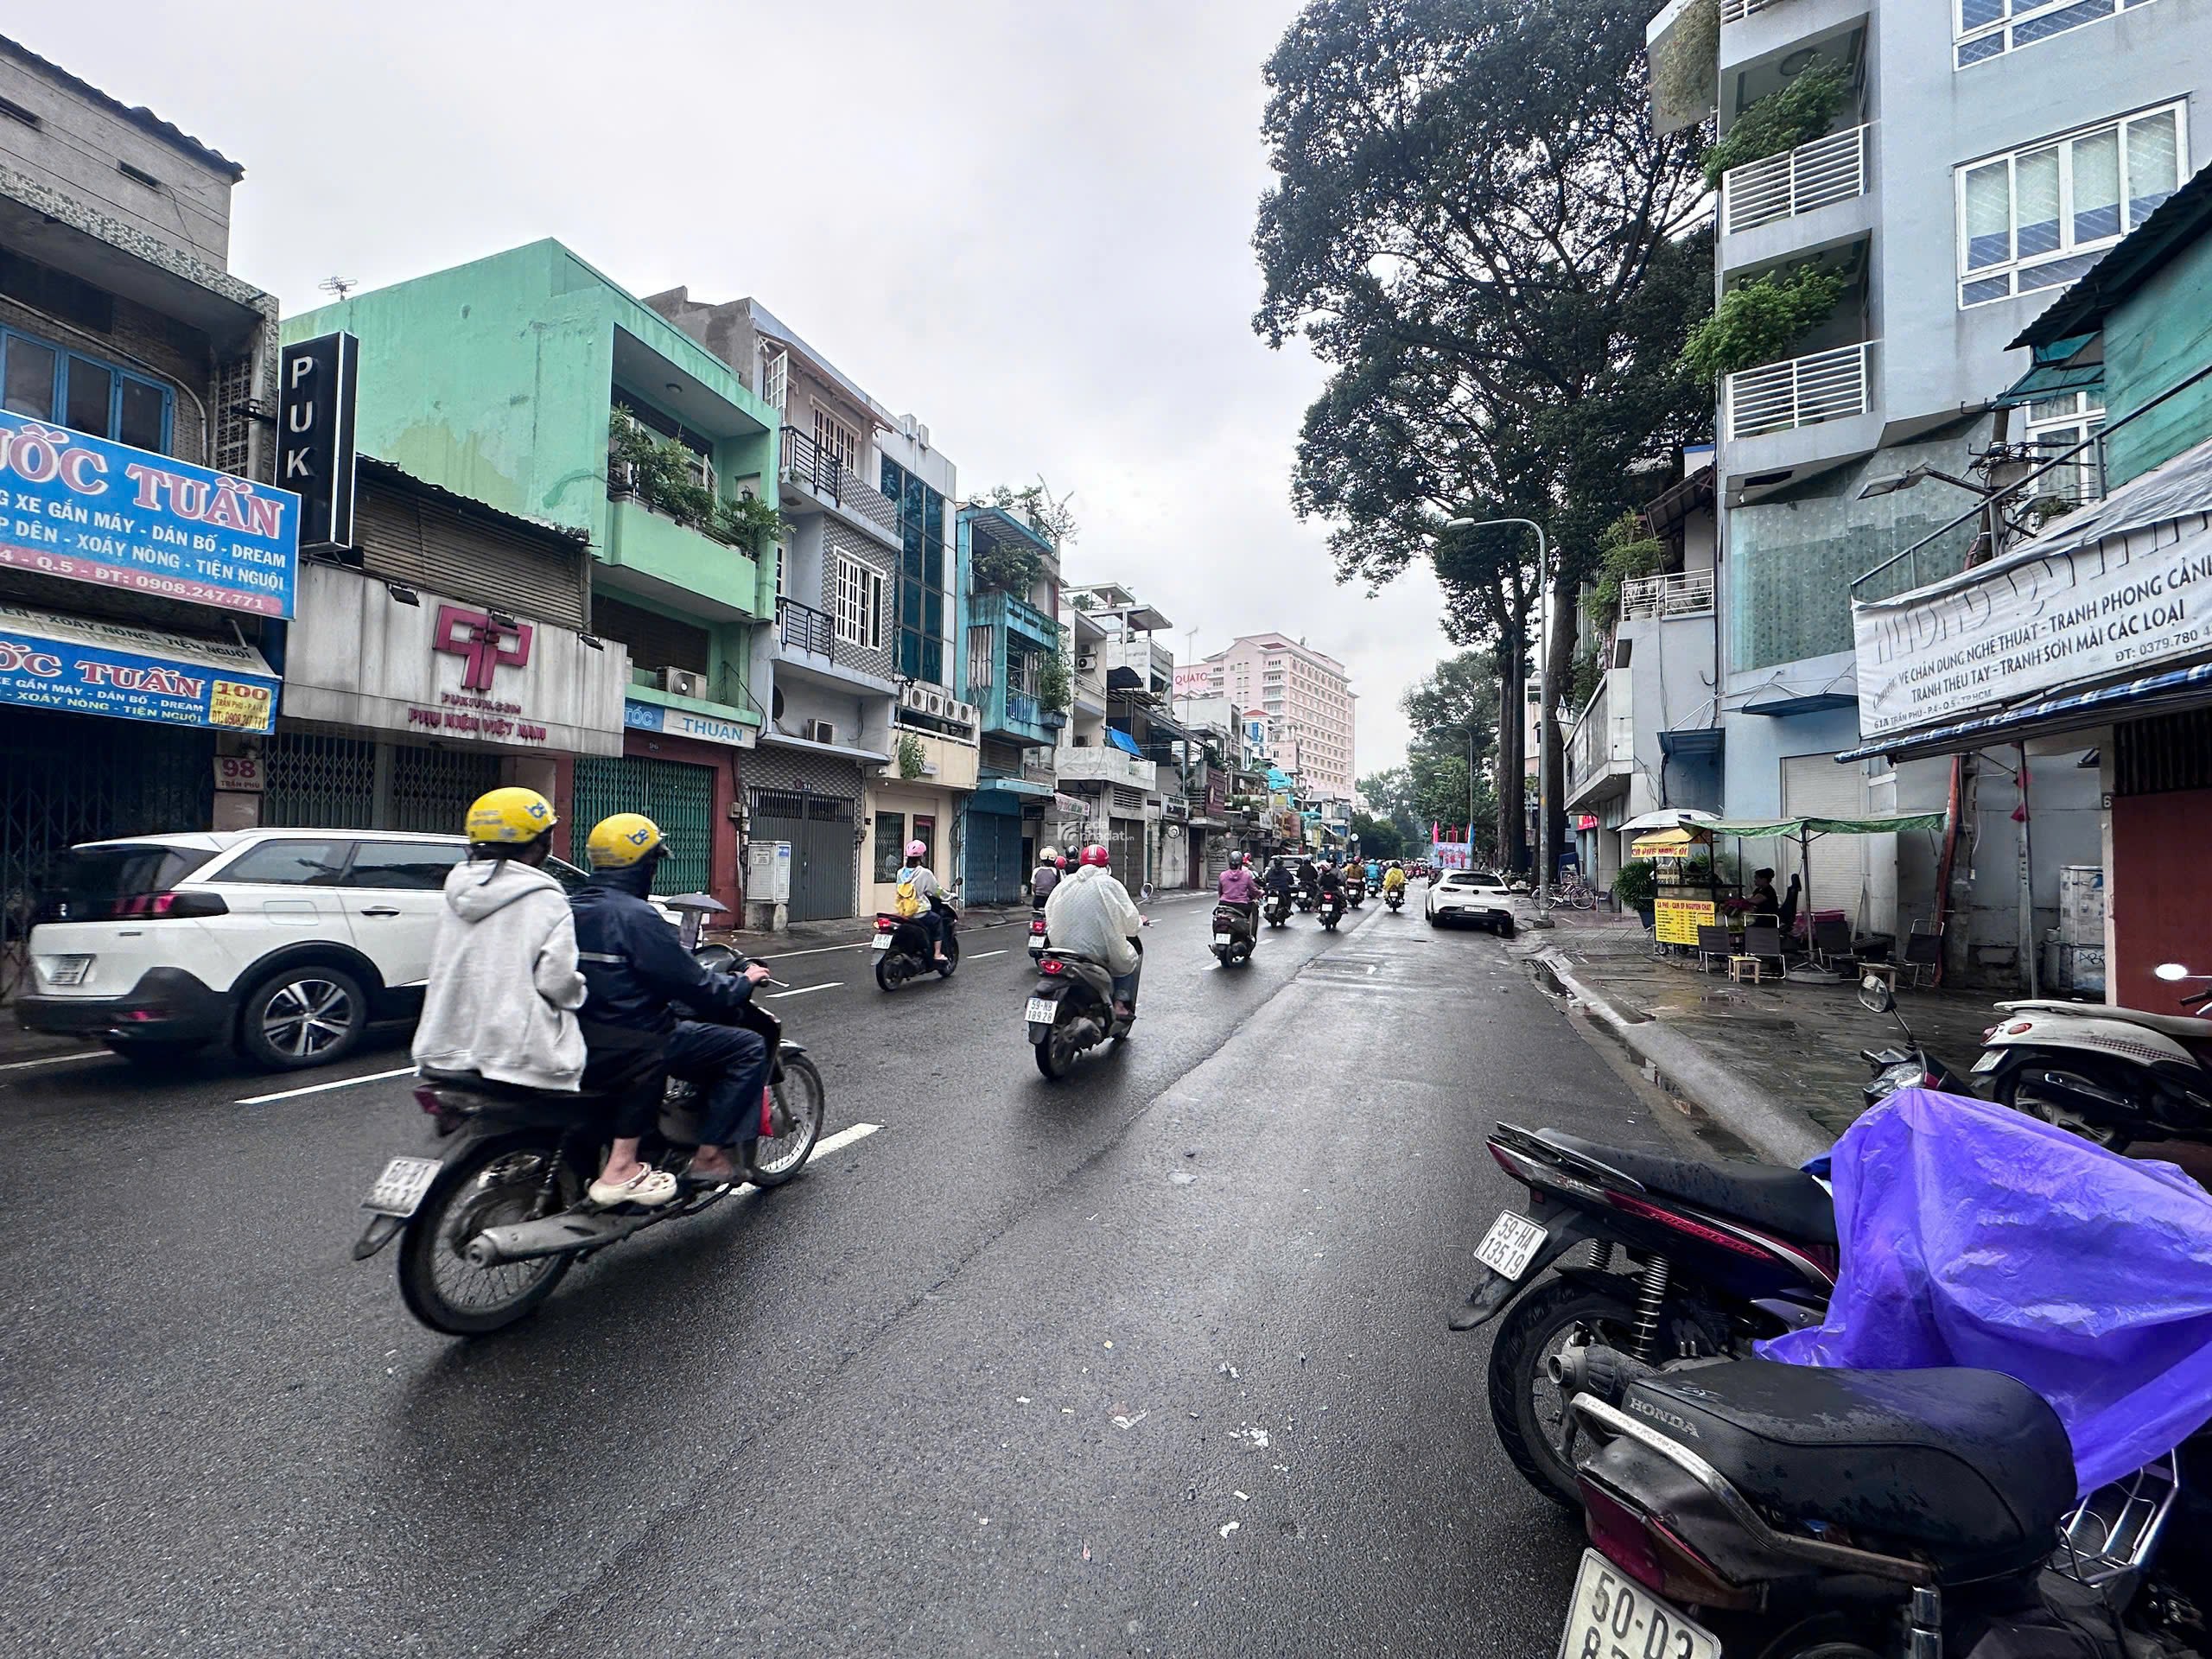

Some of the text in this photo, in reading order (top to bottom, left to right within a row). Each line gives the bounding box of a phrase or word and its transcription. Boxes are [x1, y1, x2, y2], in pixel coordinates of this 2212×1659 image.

[286, 355, 314, 479] PUK
[126, 463, 285, 539] TUẤN
[15, 493, 41, 513] XE
[48, 499, 88, 524] GẮN
[94, 512, 135, 534] MÁY
[152, 525, 188, 547] DÁN
[194, 534, 219, 552] BỐ
[232, 543, 286, 569] DREAM
[16, 520, 58, 543] DÊN
[77, 534, 127, 557] XOÁY
[132, 545, 180, 569] NÒNG
[196, 559, 233, 580] TIỆN
[238, 569, 283, 591] NGUỘI
[36, 556, 73, 573] Q.5
[95, 568, 129, 584] ĐT:
[137, 576, 264, 609] 0908.247.771
[1937, 652, 1965, 673] DUNG
[2049, 601, 2097, 632] TRANH
[2101, 575, 2163, 614] PHONG
[1911, 681, 1941, 703] TRANH
[1972, 664, 1991, 684] TAY
[1999, 648, 2041, 677] TRANH
[2044, 634, 2072, 662] SƠN
[2076, 624, 2103, 652] MÀI
[2107, 613, 2139, 641] CÁC
[2144, 599, 2184, 632] LOẠI
[2115, 648, 2135, 662] ĐT:
[2139, 630, 2198, 655] 0379.780
[52, 684, 83, 696] MÁY
[97, 690, 125, 702] DÁN
[161, 699, 204, 712] DREAM
[73, 660, 206, 699] TUẤN
[217, 683, 268, 701] 100
[17, 692, 62, 704] XOÁY
[67, 698, 110, 710] NÒNG
[123, 706, 157, 717] TIỆN
[162, 711, 201, 722] NGUỘI
[1874, 717, 1889, 729] 61A
[518, 723, 547, 741] NAM
[222, 760, 257, 779] 98
[1497, 1217, 1537, 1251] 59-HA
[1481, 1237, 1525, 1274] 135.19
[1630, 1396, 1700, 1439] HONDA
